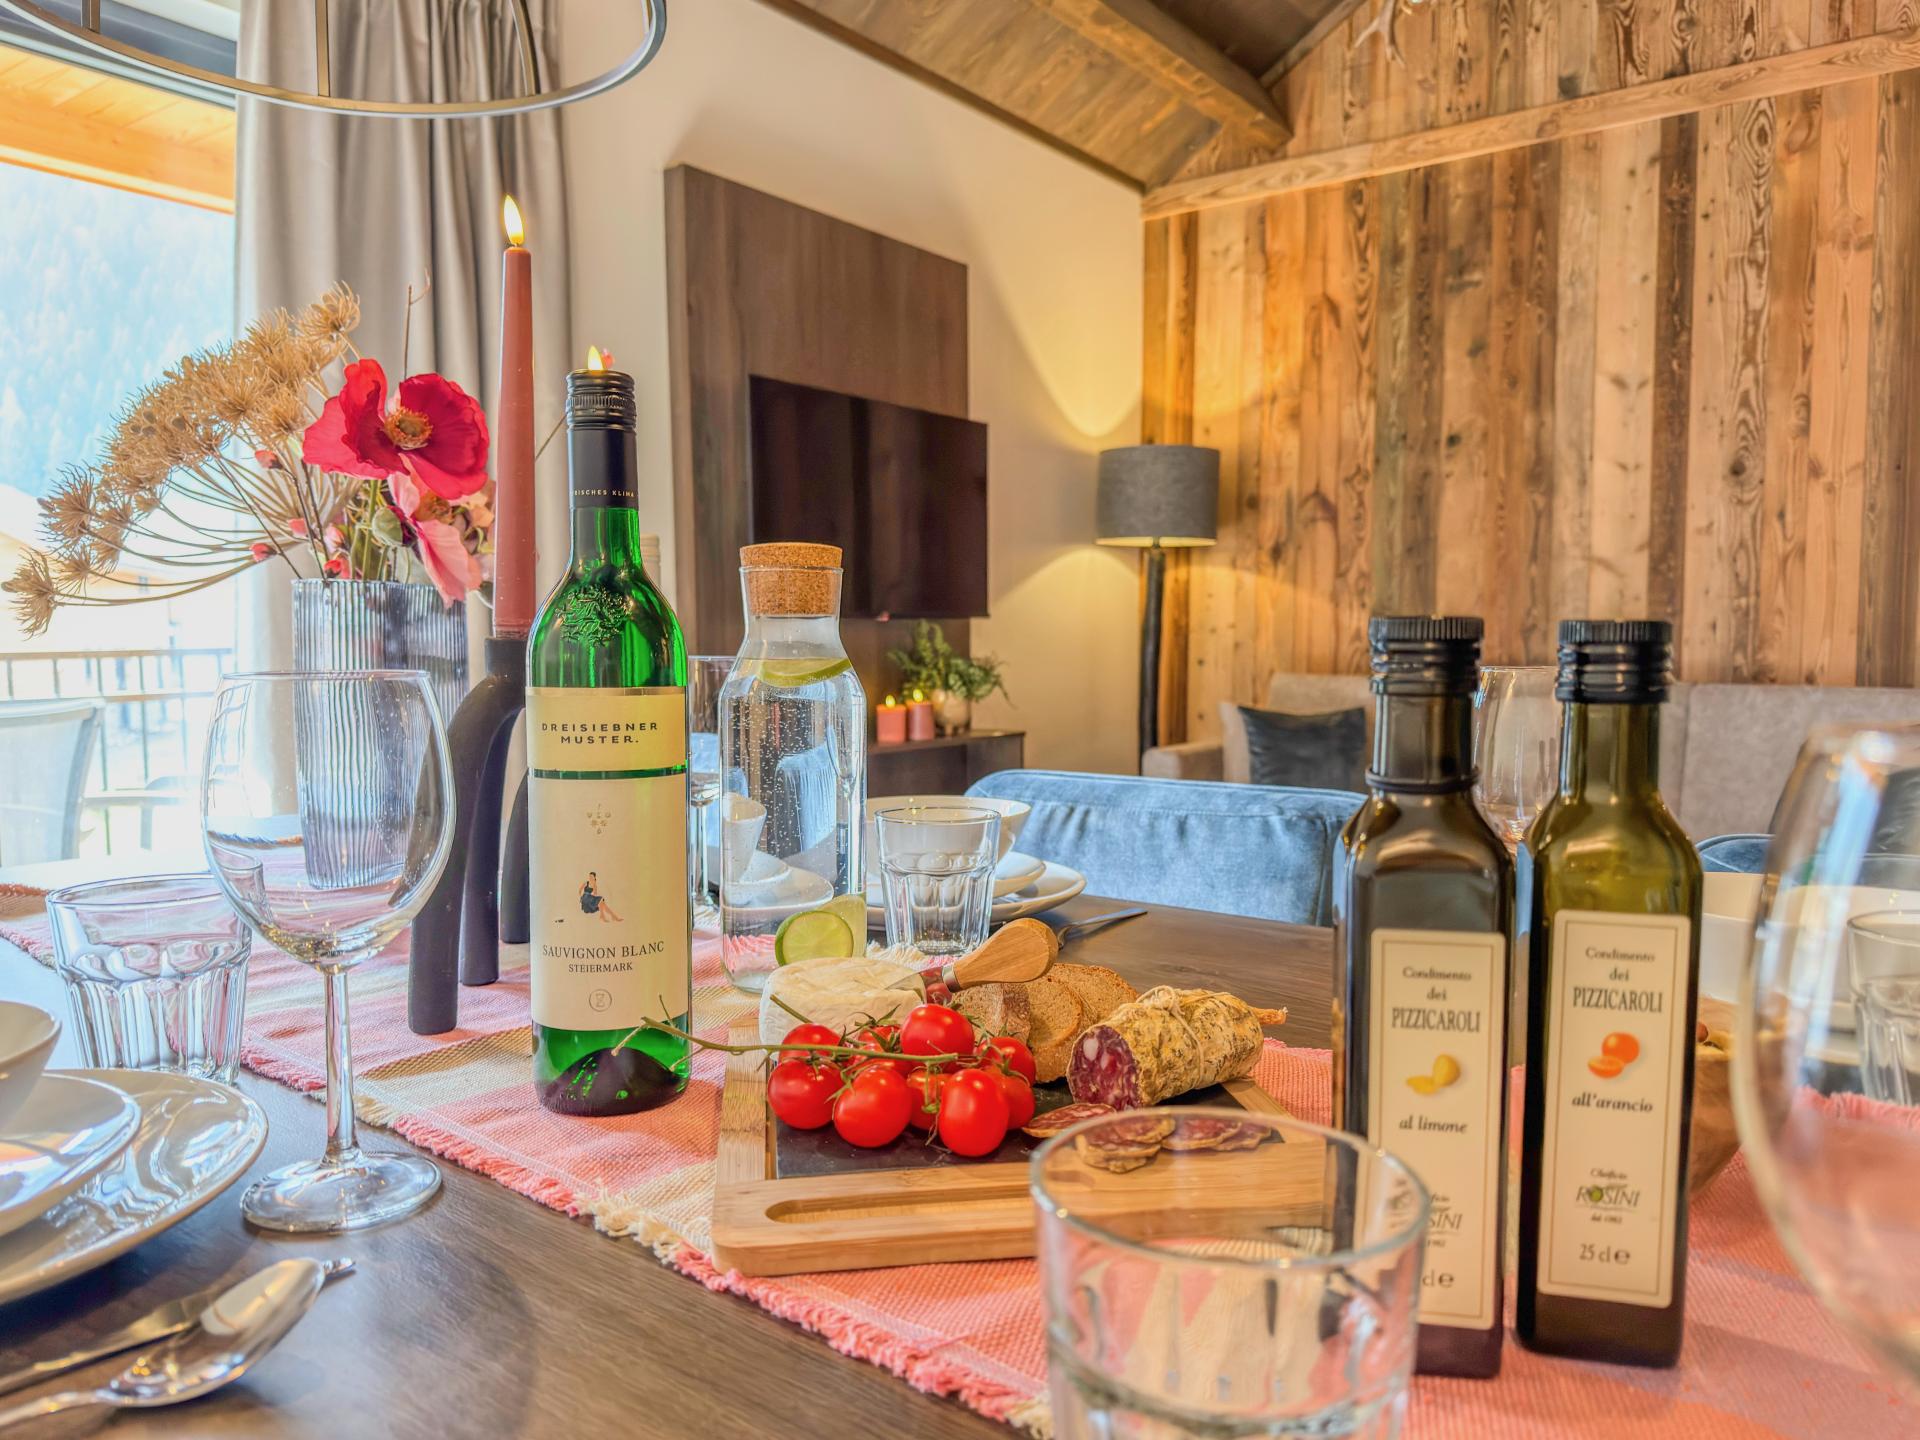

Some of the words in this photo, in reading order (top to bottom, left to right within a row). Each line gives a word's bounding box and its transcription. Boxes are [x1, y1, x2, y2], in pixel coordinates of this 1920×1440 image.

[612, 490, 635, 498] KLIMA
[541, 722, 658, 732] DREISIEBNER
[560, 735, 639, 744] MUSTER.
[542, 944, 616, 960] SAUVIGNON
[621, 940, 665, 957] BLANC
[1585, 946, 1655, 963] Condimento
[568, 962, 633, 973] STEIERMARK
[1402, 966, 1472, 981] Condimento
[1609, 967, 1629, 982] dei
[1426, 987, 1447, 1001] dei
[1573, 986, 1663, 1014] PIZZICAROLI
[1391, 1007, 1480, 1033] PIZZICAROLI
[1572, 1092, 1653, 1113] all'arancio
[1398, 1115, 1413, 1131] al
[1418, 1116, 1468, 1133] limone
[1575, 1184, 1641, 1208] ROSINI
[1429, 1212, 1463, 1231] SINI
[1578, 1243, 1595, 1261] 25
[1598, 1246, 1611, 1263] cl
